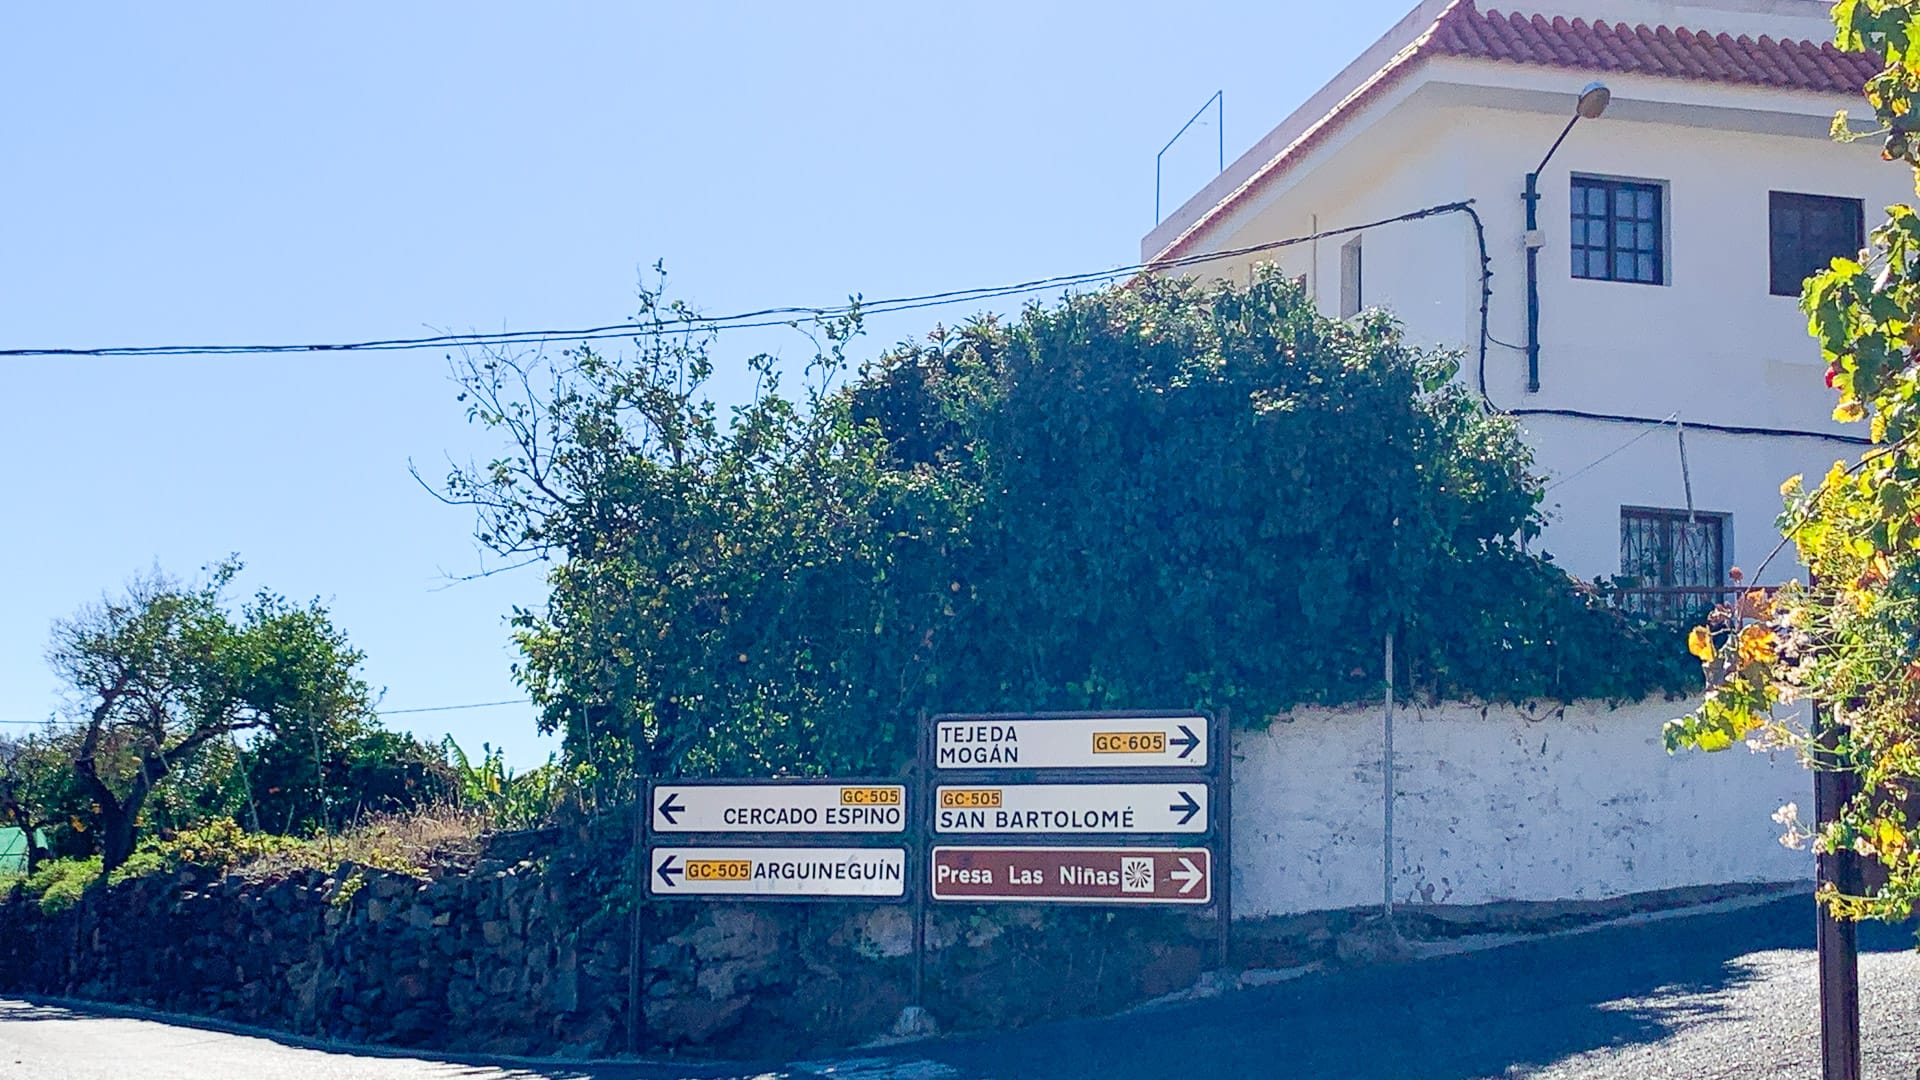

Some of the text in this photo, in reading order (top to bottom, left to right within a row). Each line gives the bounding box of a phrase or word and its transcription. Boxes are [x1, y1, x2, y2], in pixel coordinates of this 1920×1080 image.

[941, 726, 1018, 743] TEJEDA
[940, 744, 1018, 764] MOGÁN
[723, 807, 900, 825] CERCADO ESPINO
[940, 806, 1134, 828] SAN BARTOLOMÉ
[754, 859, 900, 880] ARGUINEGUÍN
[937, 865, 1120, 885] Presa Las Niñas
